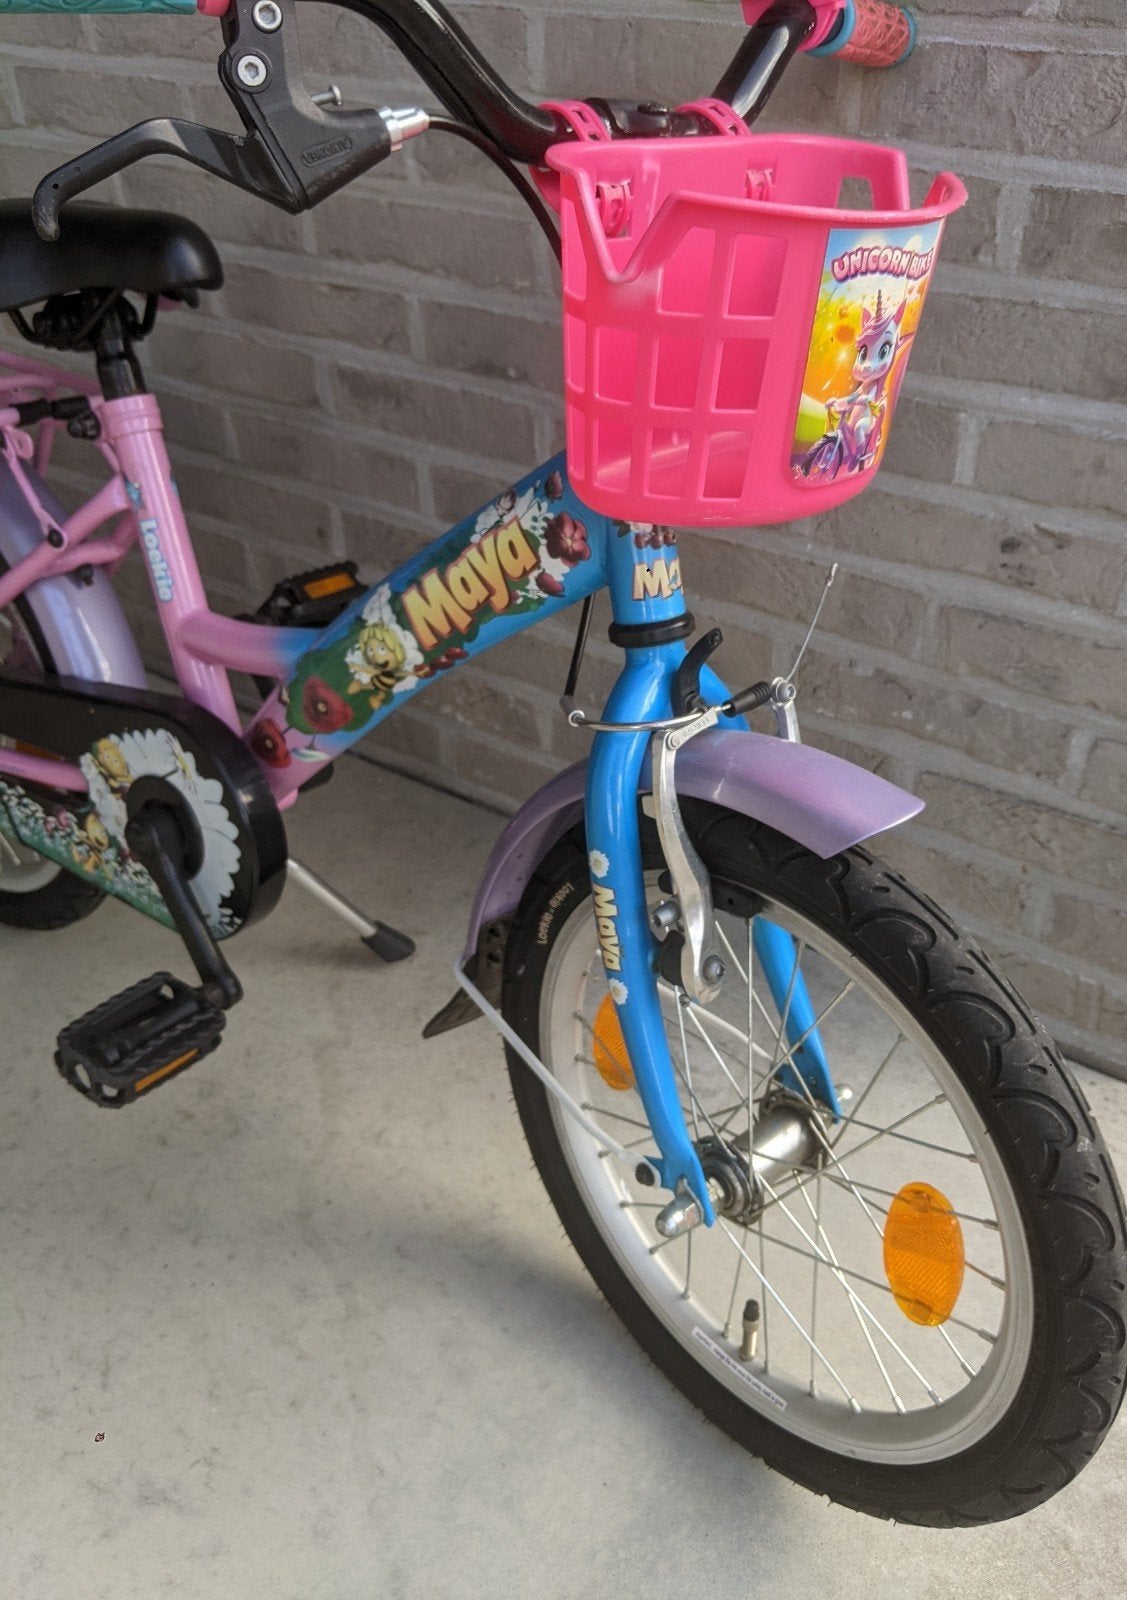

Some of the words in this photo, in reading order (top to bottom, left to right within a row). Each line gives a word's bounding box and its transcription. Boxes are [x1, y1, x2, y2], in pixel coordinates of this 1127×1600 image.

[831, 245, 911, 283] UNICORN
[906, 247, 934, 280] BIKE
[139, 519, 173, 602] Loekie
[401, 515, 541, 652] Maya
[632, 556, 684, 600] Ma
[591, 882, 621, 971] Maya
